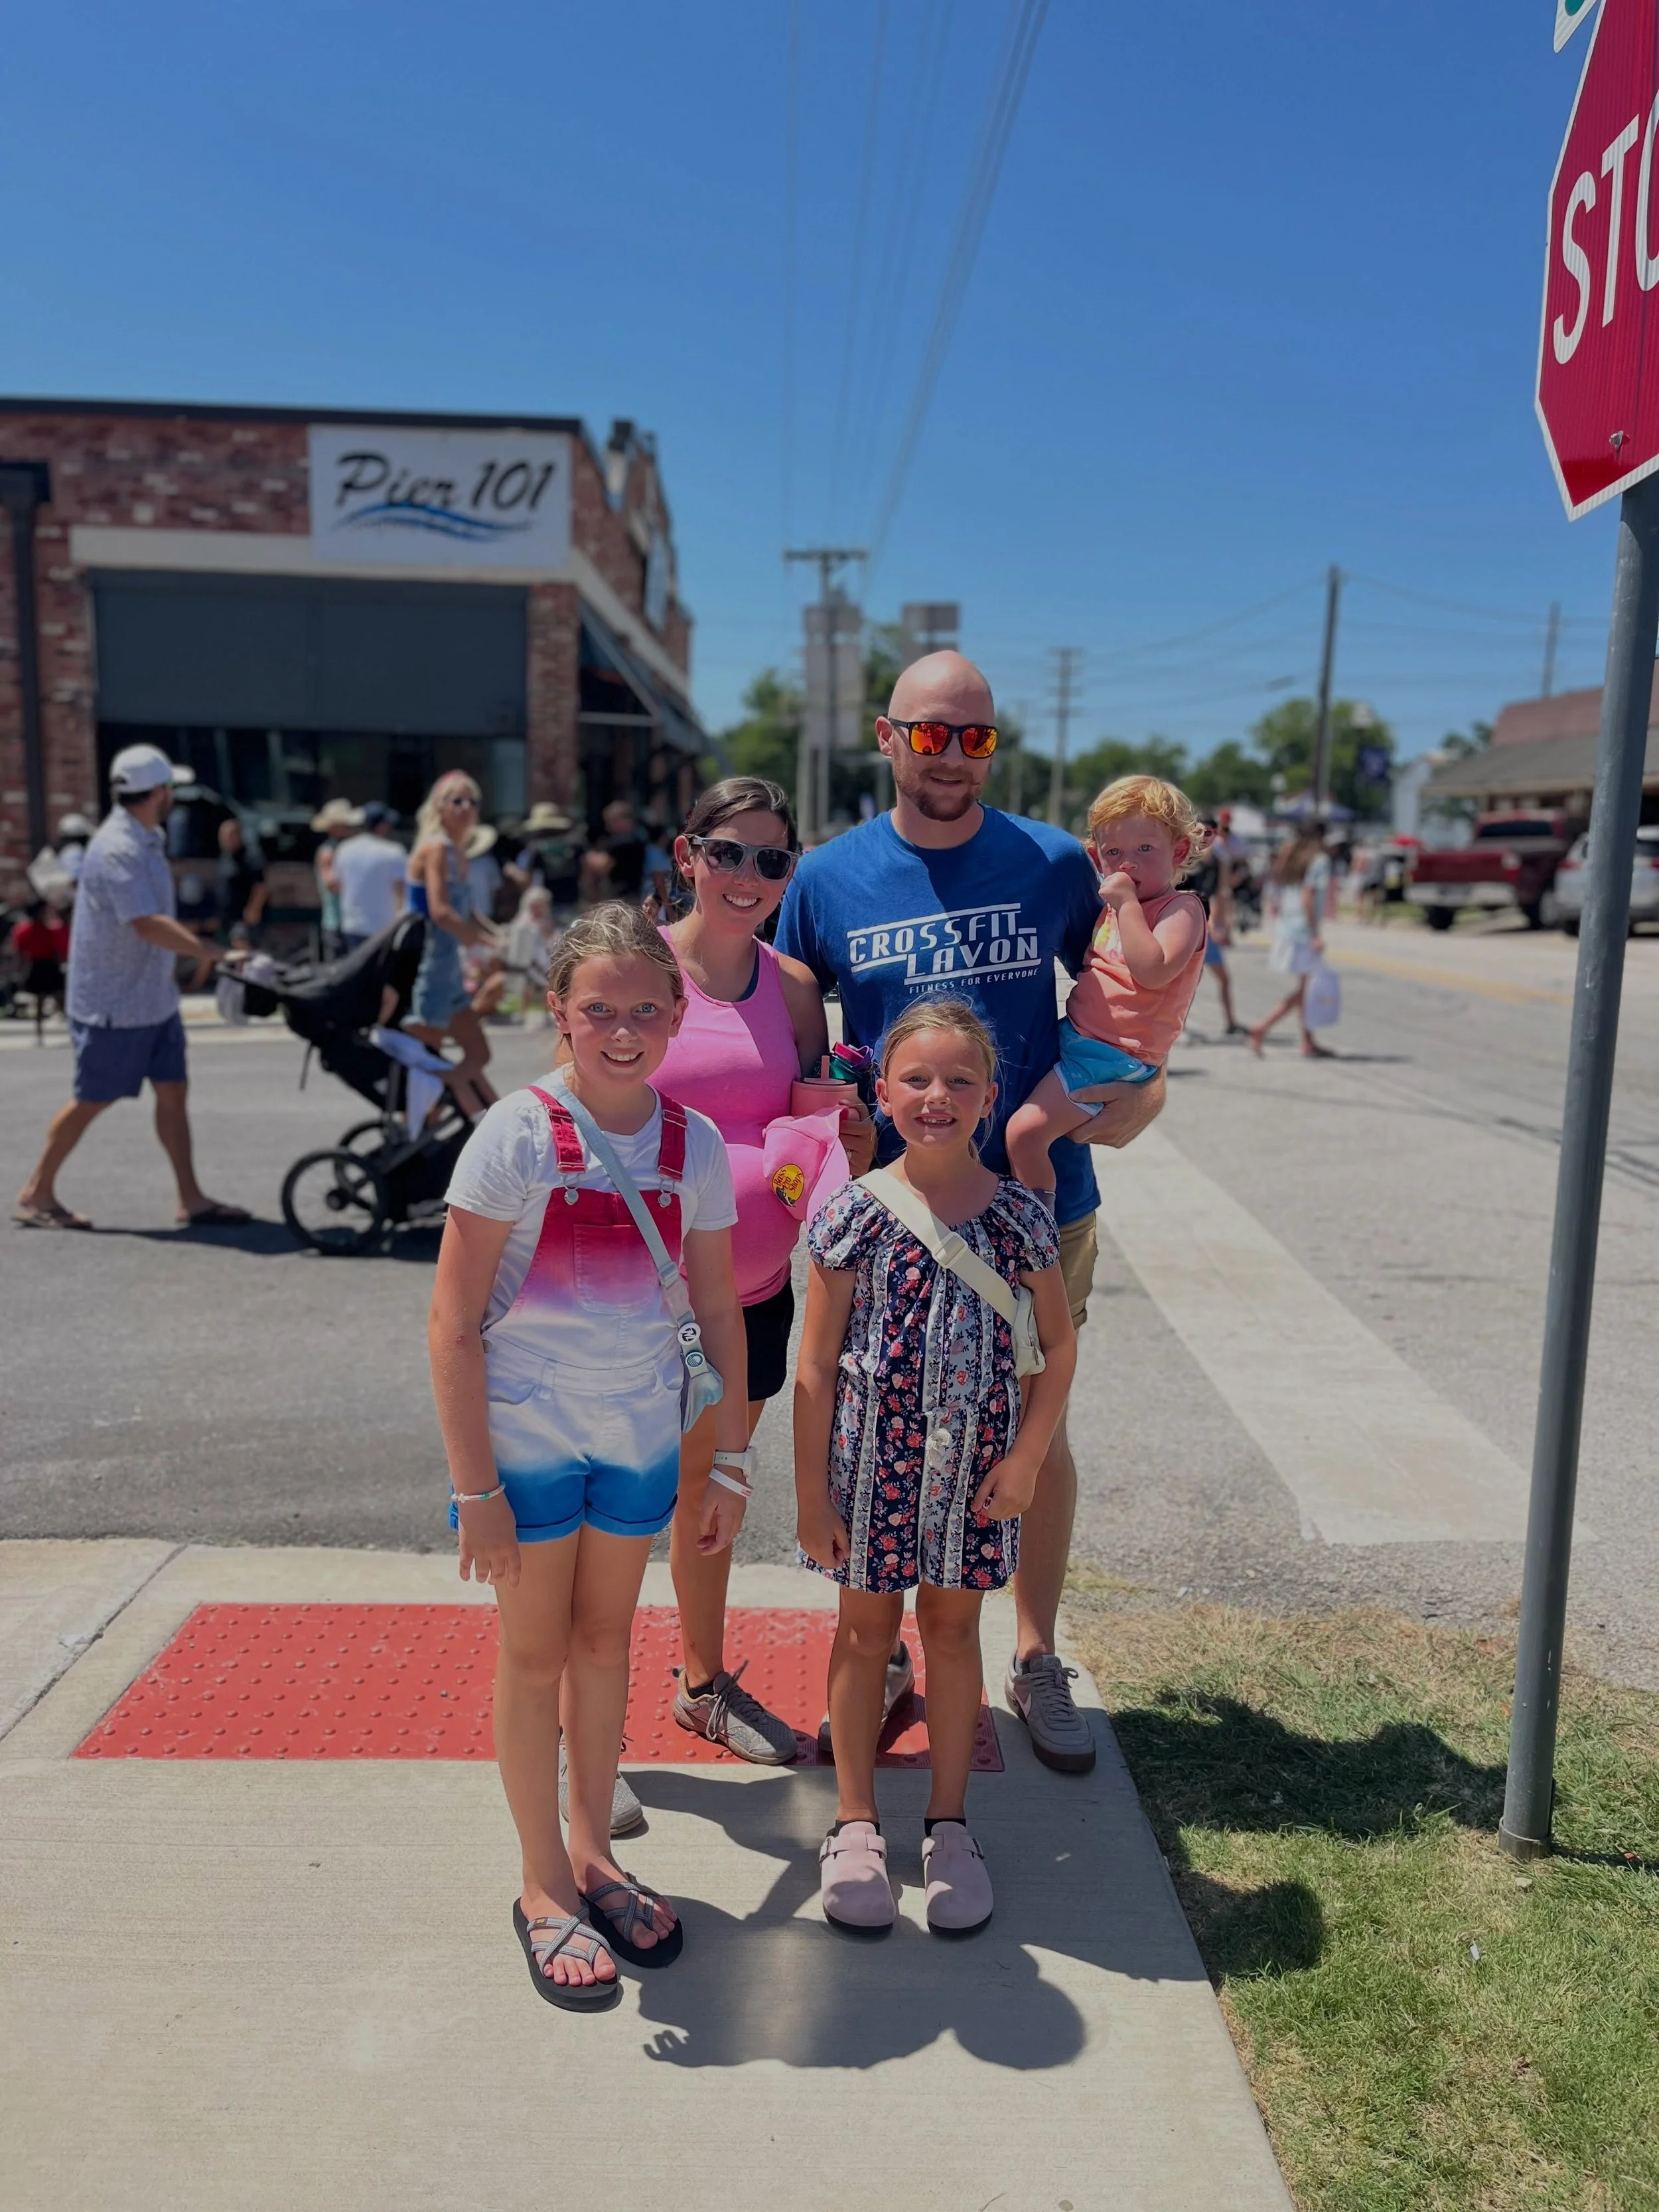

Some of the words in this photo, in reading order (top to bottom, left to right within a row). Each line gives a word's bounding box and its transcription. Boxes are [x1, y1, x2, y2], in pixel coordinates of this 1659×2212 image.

[333, 451, 456, 509] Pier
[471, 462, 555, 511] 101
[849, 911, 1022, 964] CROSSFIT
[906, 936, 1038, 978] LAVON
[909, 981, 955, 994] FITNESS
[961, 976, 981, 987] FOR
[986, 968, 1039, 984] EVERYONE
[773, 1169, 787, 1187] Bass
[782, 1177, 792, 1190] Pro
[788, 1172, 803, 1194] Shops
